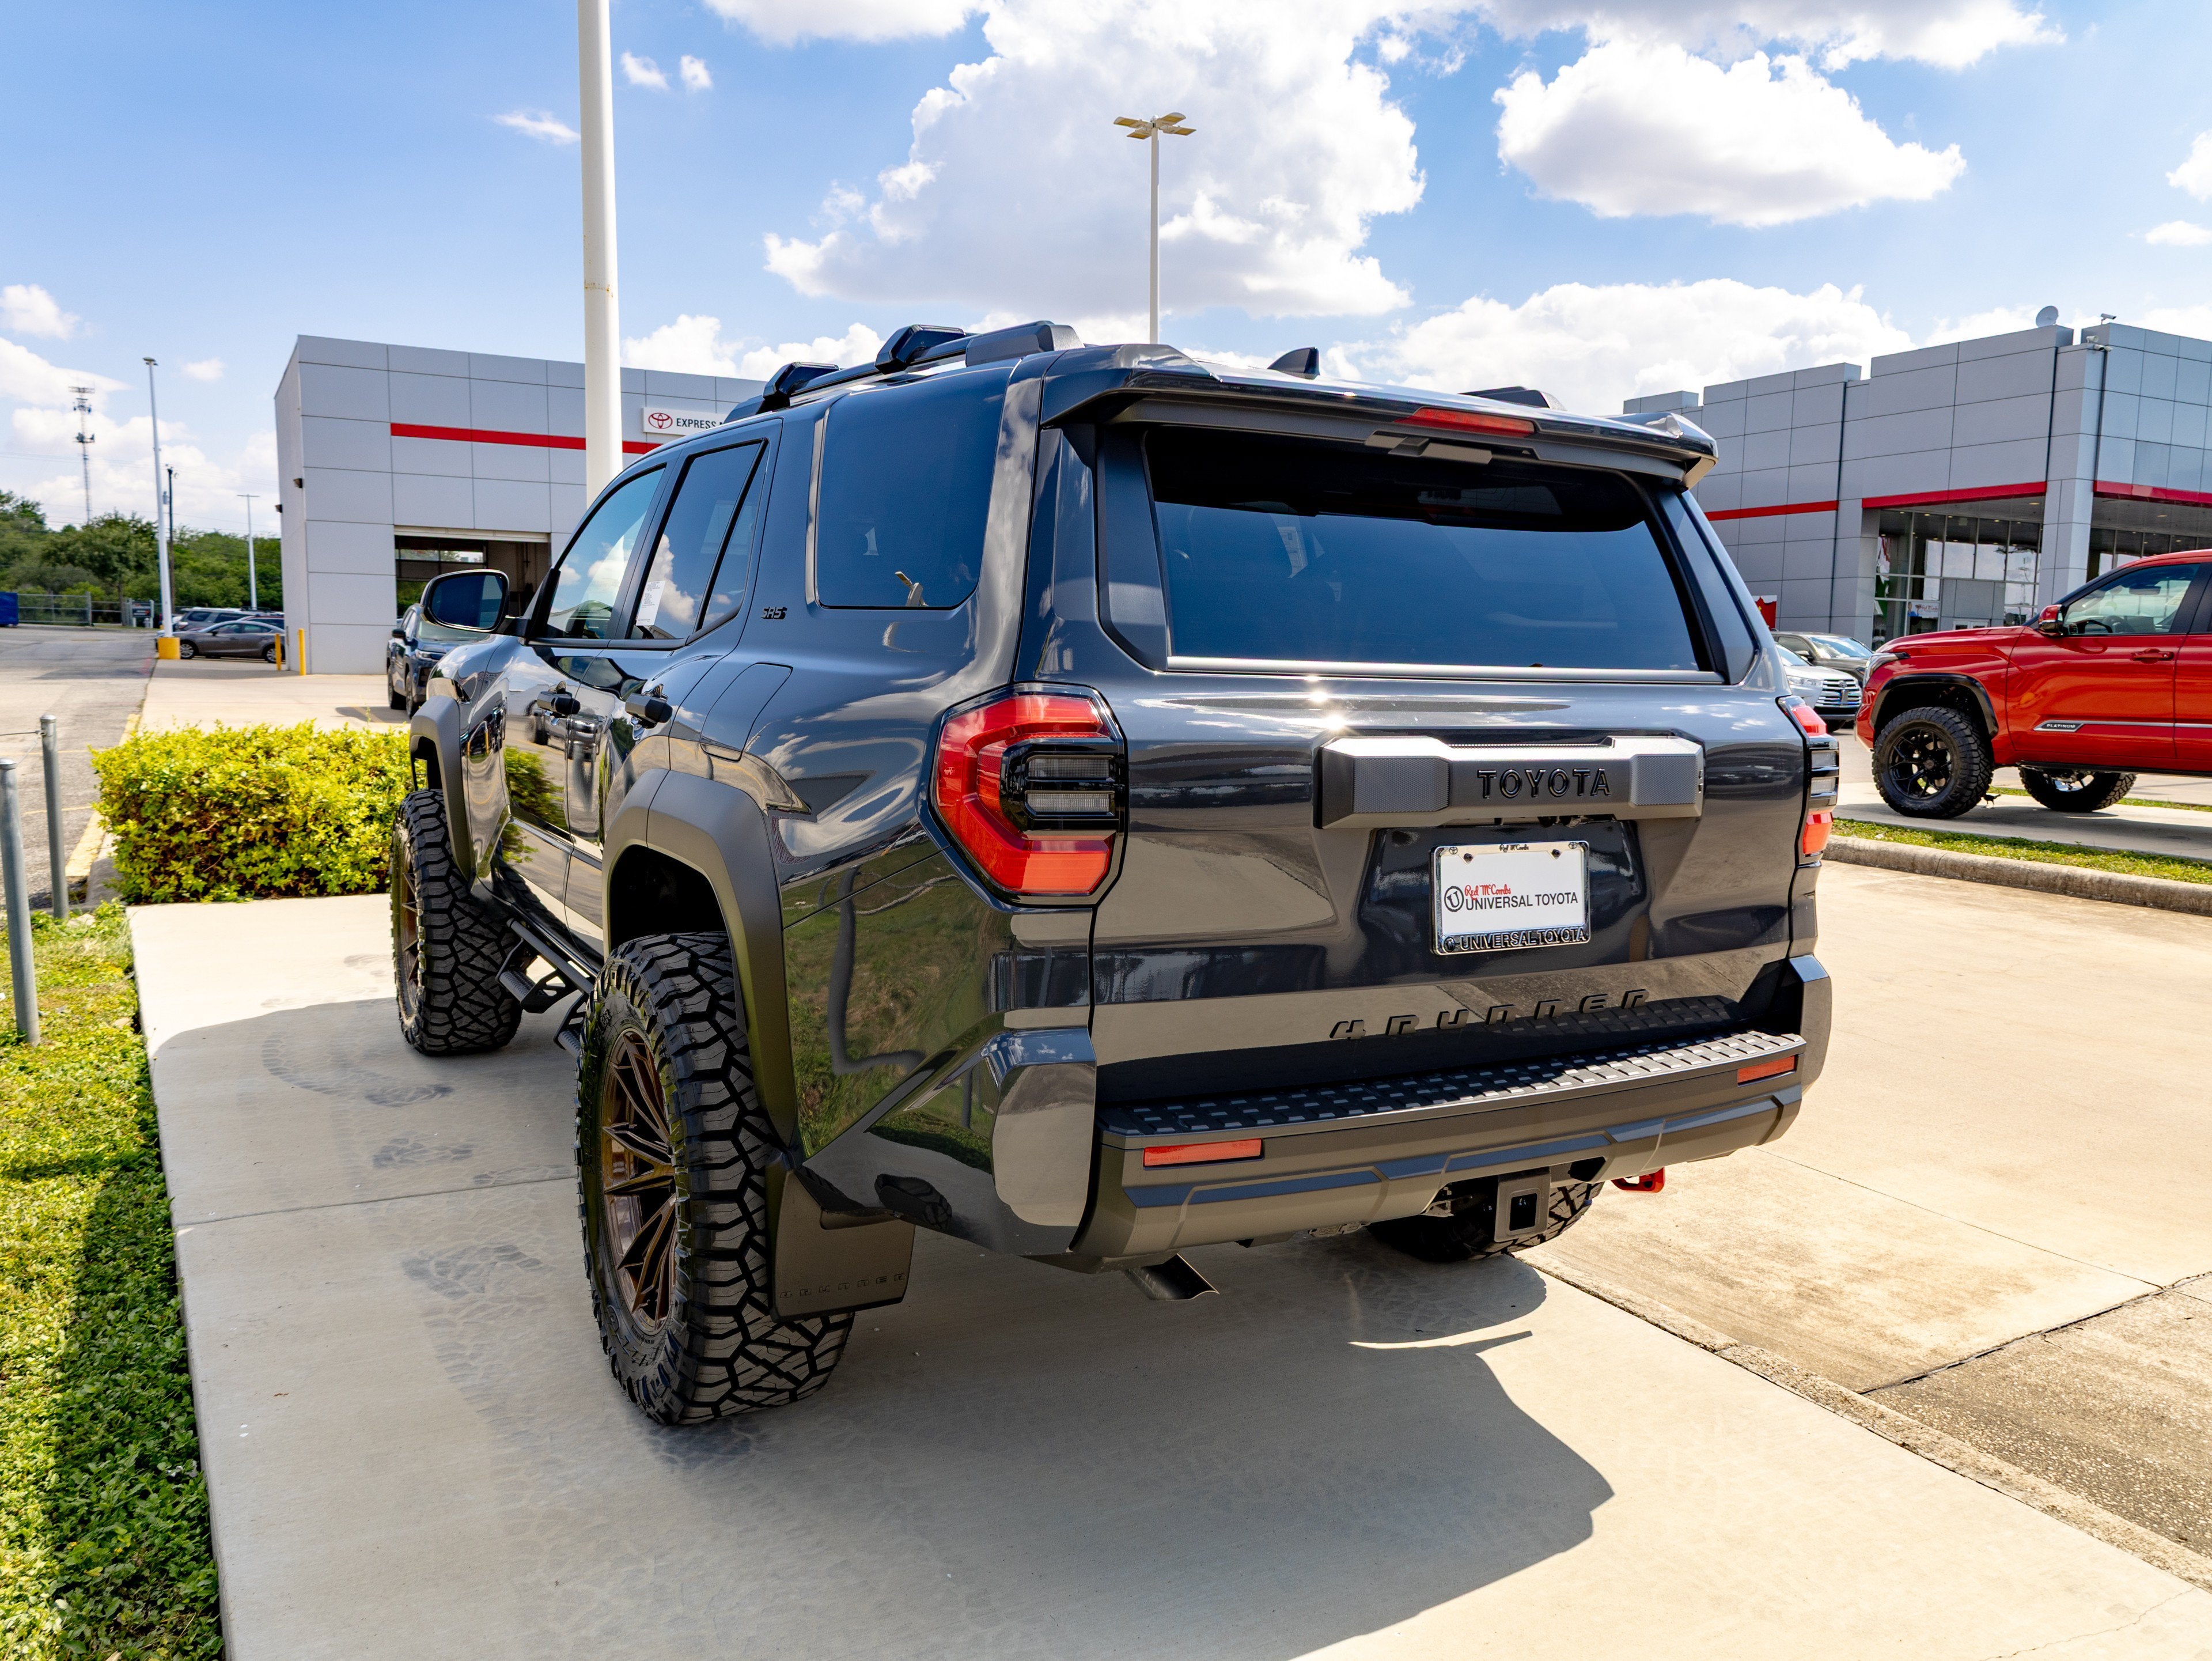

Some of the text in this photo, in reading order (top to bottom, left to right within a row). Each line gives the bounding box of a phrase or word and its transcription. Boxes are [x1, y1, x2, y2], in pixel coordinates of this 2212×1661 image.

[676, 418, 717, 429] EXPRESS
[761, 607, 787, 619] SR5
[1478, 769, 1611, 799] TOYOTA
[1480, 884, 1511, 895] McCombs
[1465, 892, 1578, 910] UNIVERSAL TOYOTA
[1460, 930, 1537, 951] UNIVERSAL
[1536, 926, 1586, 944] TOYOTA
